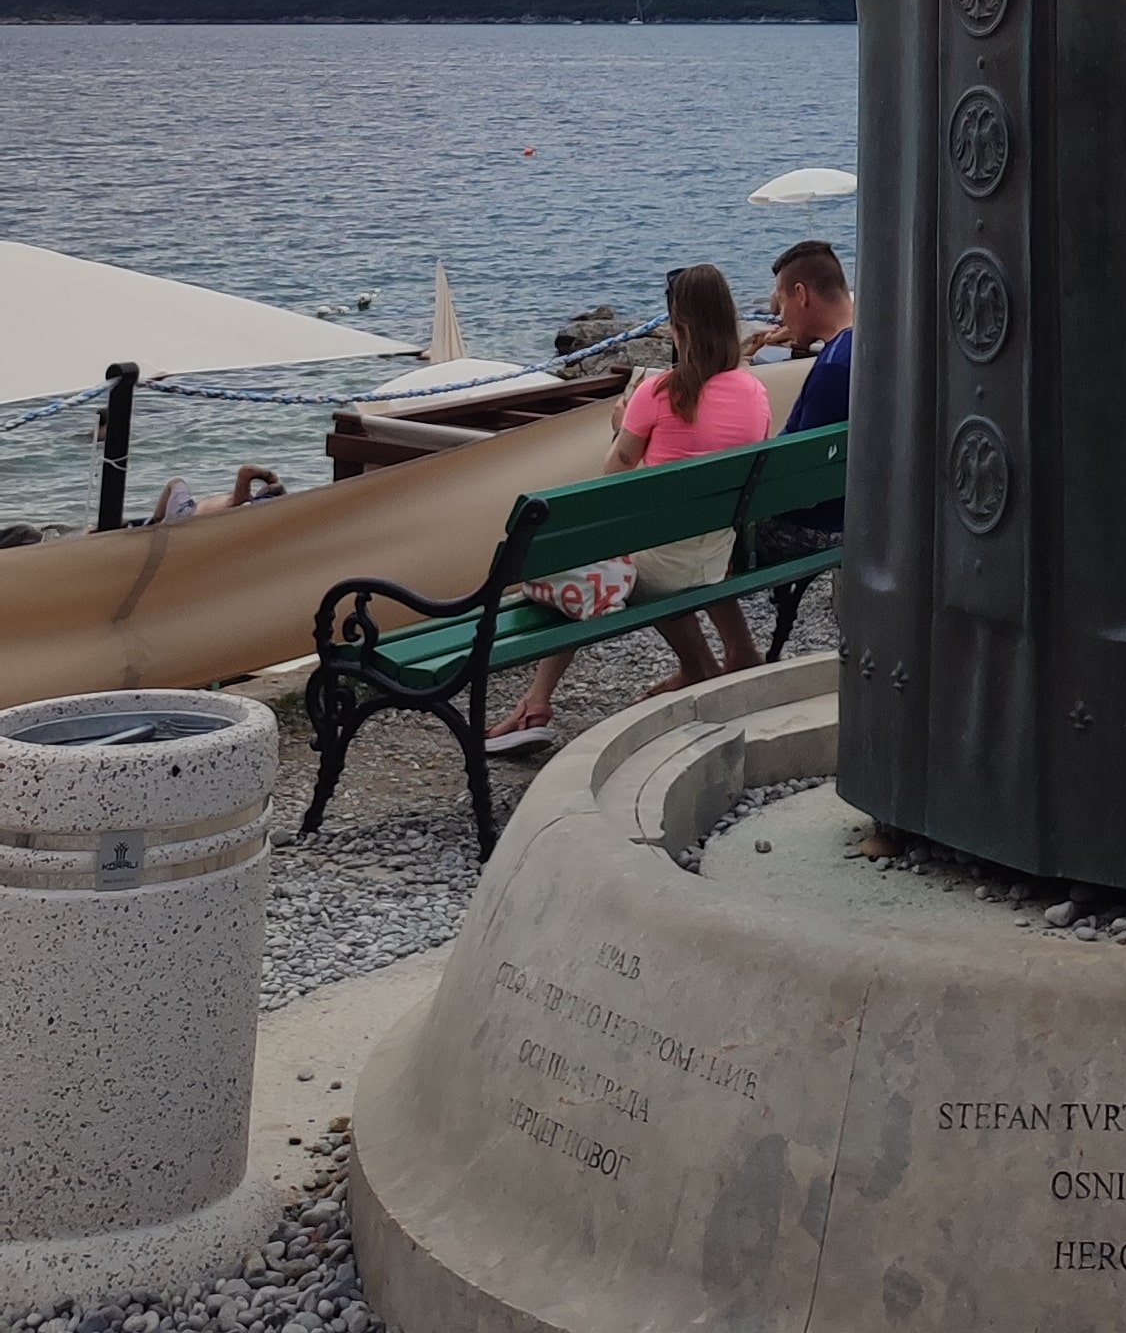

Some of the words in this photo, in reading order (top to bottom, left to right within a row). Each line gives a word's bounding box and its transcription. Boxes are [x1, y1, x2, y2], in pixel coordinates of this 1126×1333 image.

[496, 961, 545, 1003] СТЕФ
[543, 983, 602, 1029] ТВРТО
[610, 1013, 757, 1101] КОРОМАНИЋ
[508, 1097, 565, 1148] ЕРЦЕГ
[938, 1102, 1052, 1131] STEFAN
